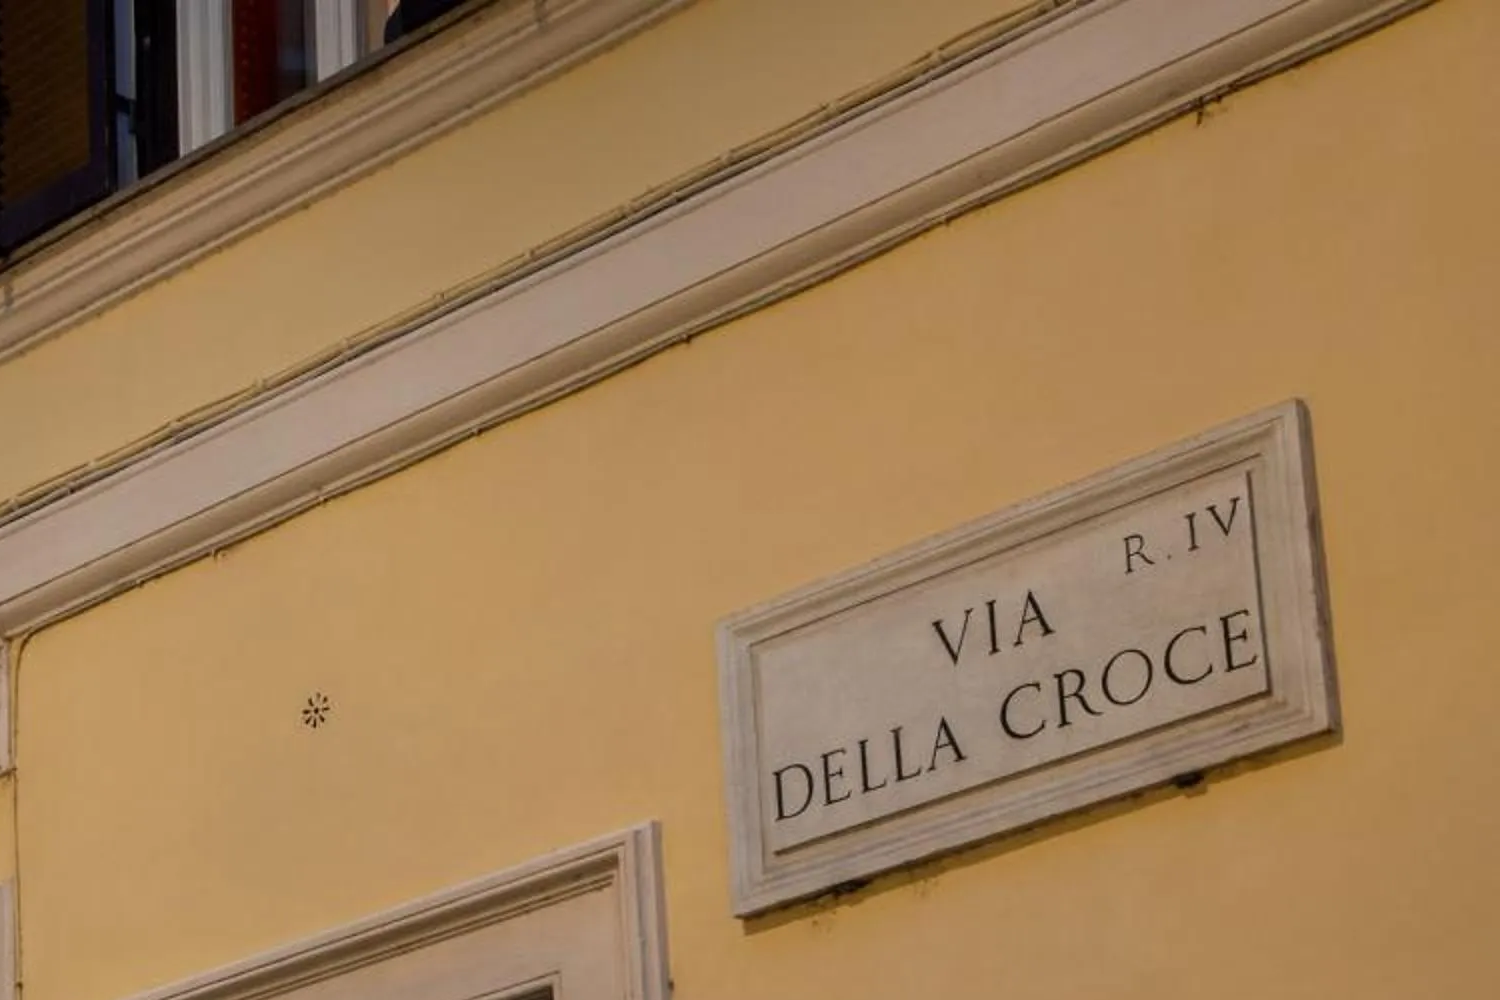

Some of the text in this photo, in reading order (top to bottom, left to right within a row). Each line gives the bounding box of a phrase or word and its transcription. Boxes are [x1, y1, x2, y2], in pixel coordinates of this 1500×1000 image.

[931, 589, 1056, 666] VIA
[773, 608, 1259, 822] DELLA CROCE
